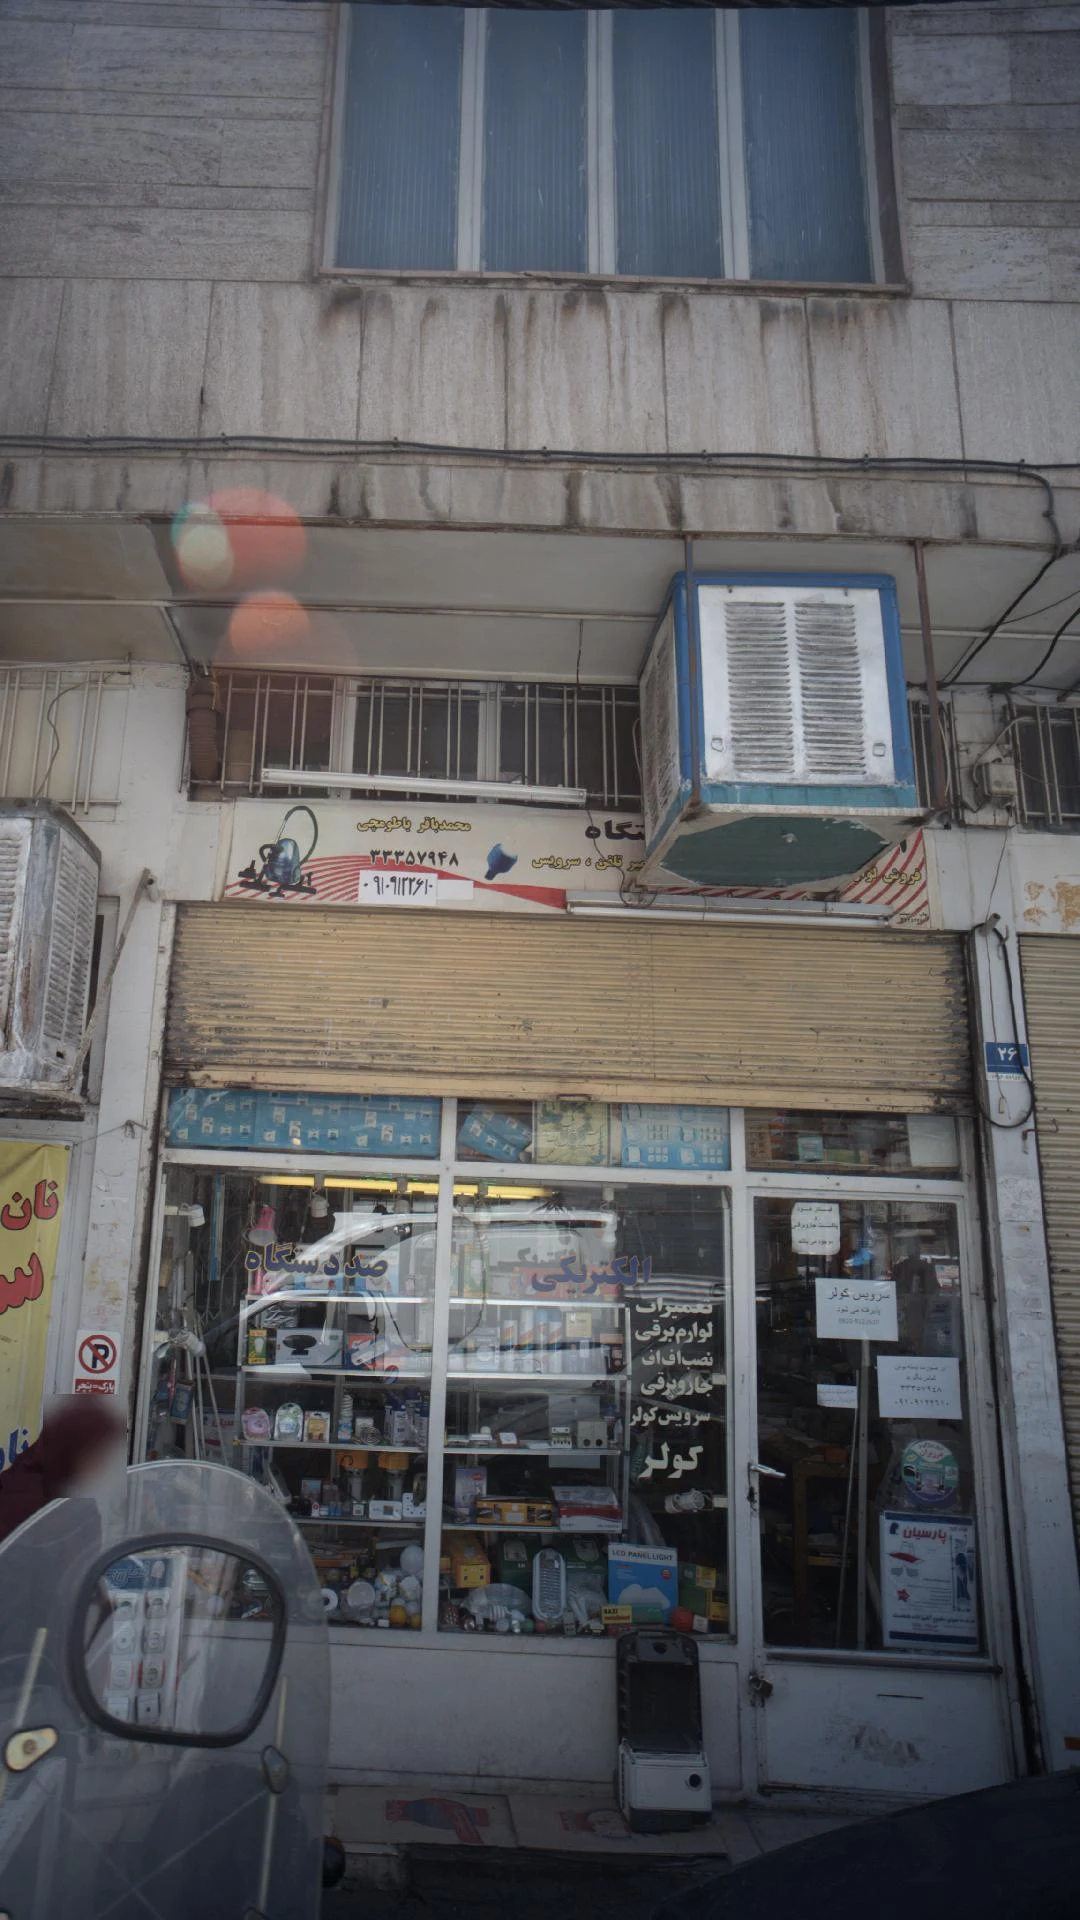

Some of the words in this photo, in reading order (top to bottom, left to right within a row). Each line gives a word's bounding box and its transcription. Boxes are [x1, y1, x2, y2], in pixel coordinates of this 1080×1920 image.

[585, 820, 646, 841] تگاه
[370, 849, 459, 867] ۳۳۳۵۷۹۴۸
[532, 855, 581, 870] سرویس
[997, 1047, 1017, 1061] ۲۶
[1, 1178, 59, 1231] نان
[531, 1255, 653, 1295] الکتریکی
[828, 1287, 849, 1301] کولر
[852, 1292, 890, 1302] سرویس
[635, 1319, 675, 1342] برقی
[682, 1351, 714, 1370] نصب
[629, 1406, 658, 1427] کولر
[658, 1409, 711, 1427] سرویس
[638, 1441, 704, 1479] کولر
[903, 1526, 947, 1545] پارسیان
[611, 1549, 626, 1557] LED
[628, 1551, 652, 1560] PANEL
[653, 1552, 673, 1561] LIGHT
